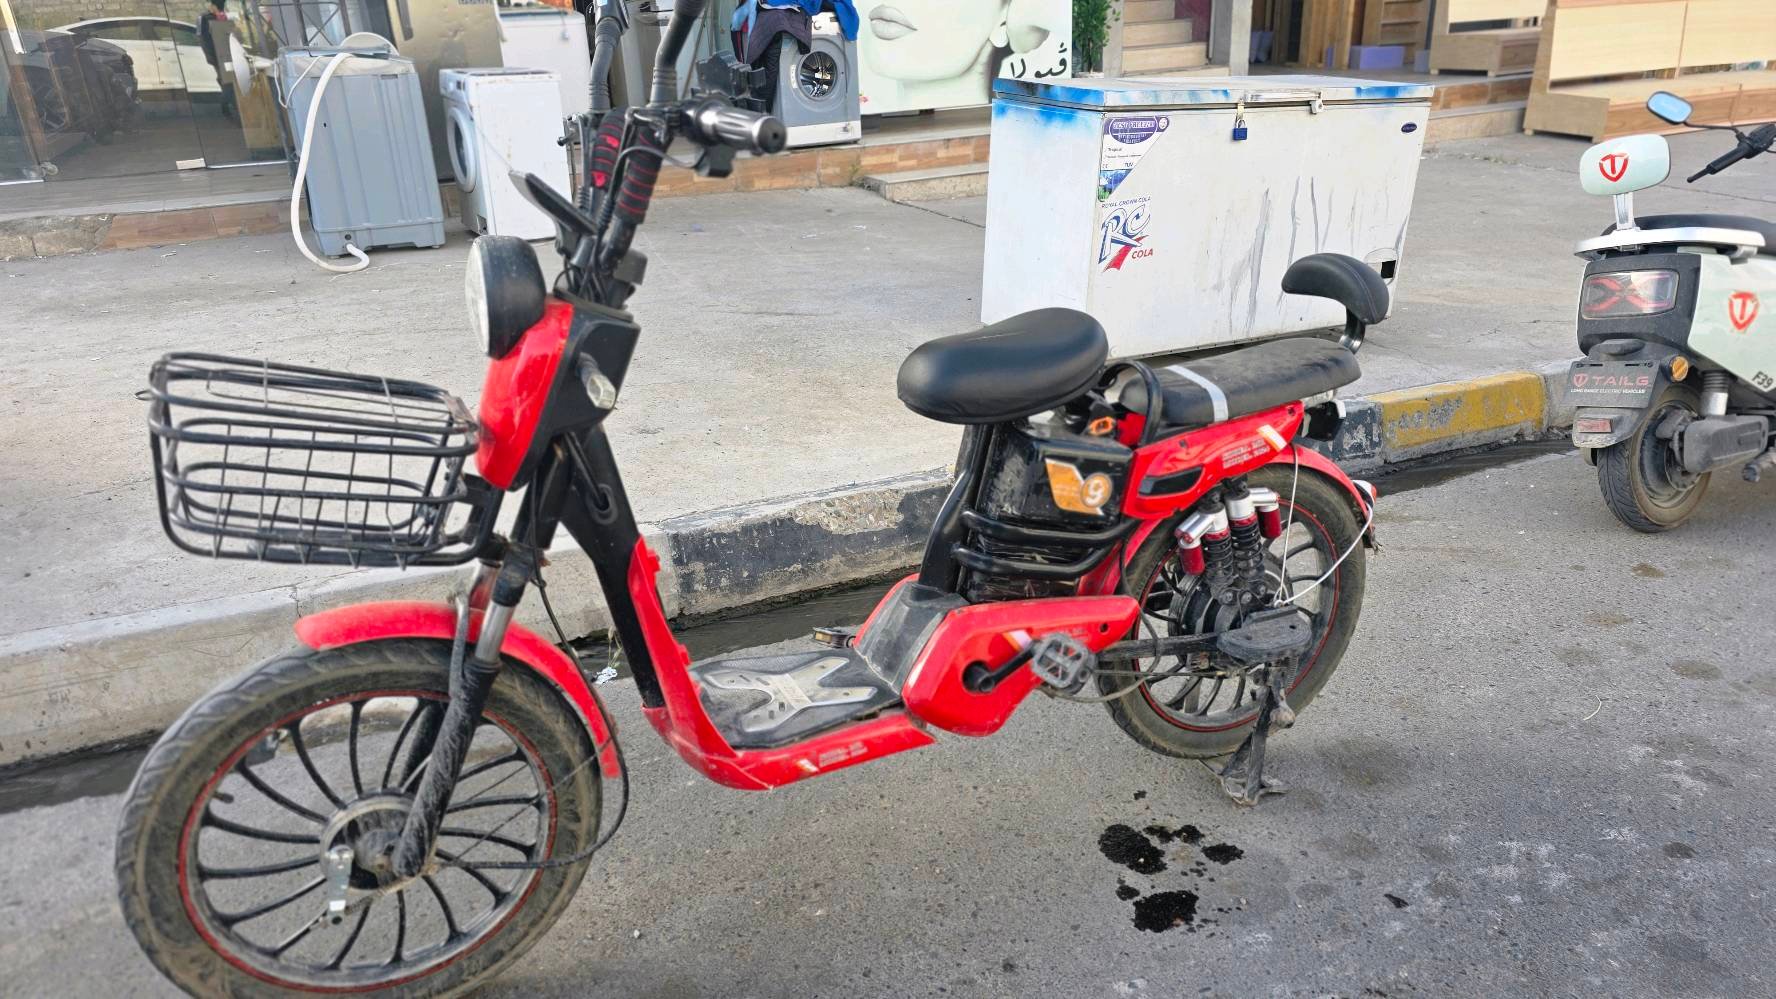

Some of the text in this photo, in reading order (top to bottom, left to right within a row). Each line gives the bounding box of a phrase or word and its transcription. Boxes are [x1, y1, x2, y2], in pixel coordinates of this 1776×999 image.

[1098, 203, 1151, 264] RC
[1131, 247, 1154, 260] COLA
[1591, 375, 1649, 386] TAILG
[1752, 370, 1774, 389] F39
